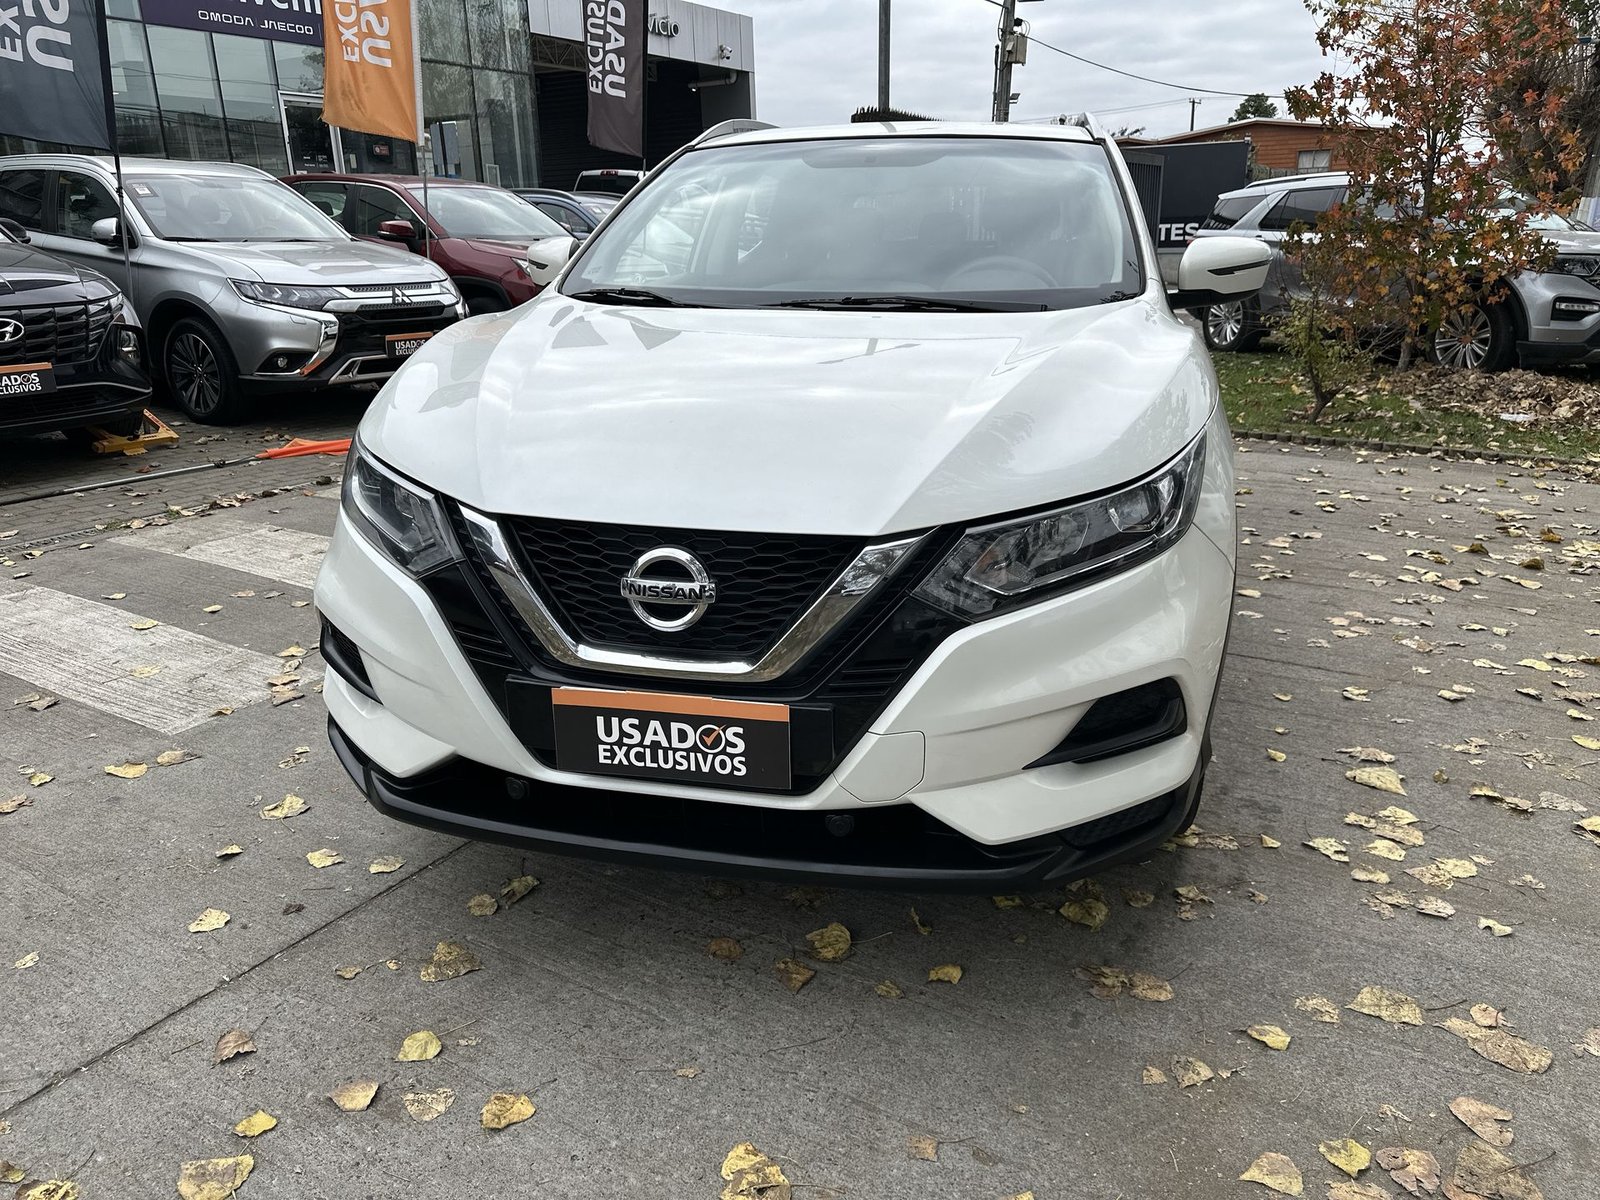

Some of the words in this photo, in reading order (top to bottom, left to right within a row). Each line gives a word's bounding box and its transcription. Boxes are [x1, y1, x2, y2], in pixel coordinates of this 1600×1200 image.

[198, 10, 255, 27] OMODA
[260, 19, 315, 35] JAECOO
[0, 372, 40, 387] ADOS
[627, 578, 704, 600] NISSAN
[595, 714, 747, 755] USADOS
[597, 744, 748, 777] EXCLUSIVOS
